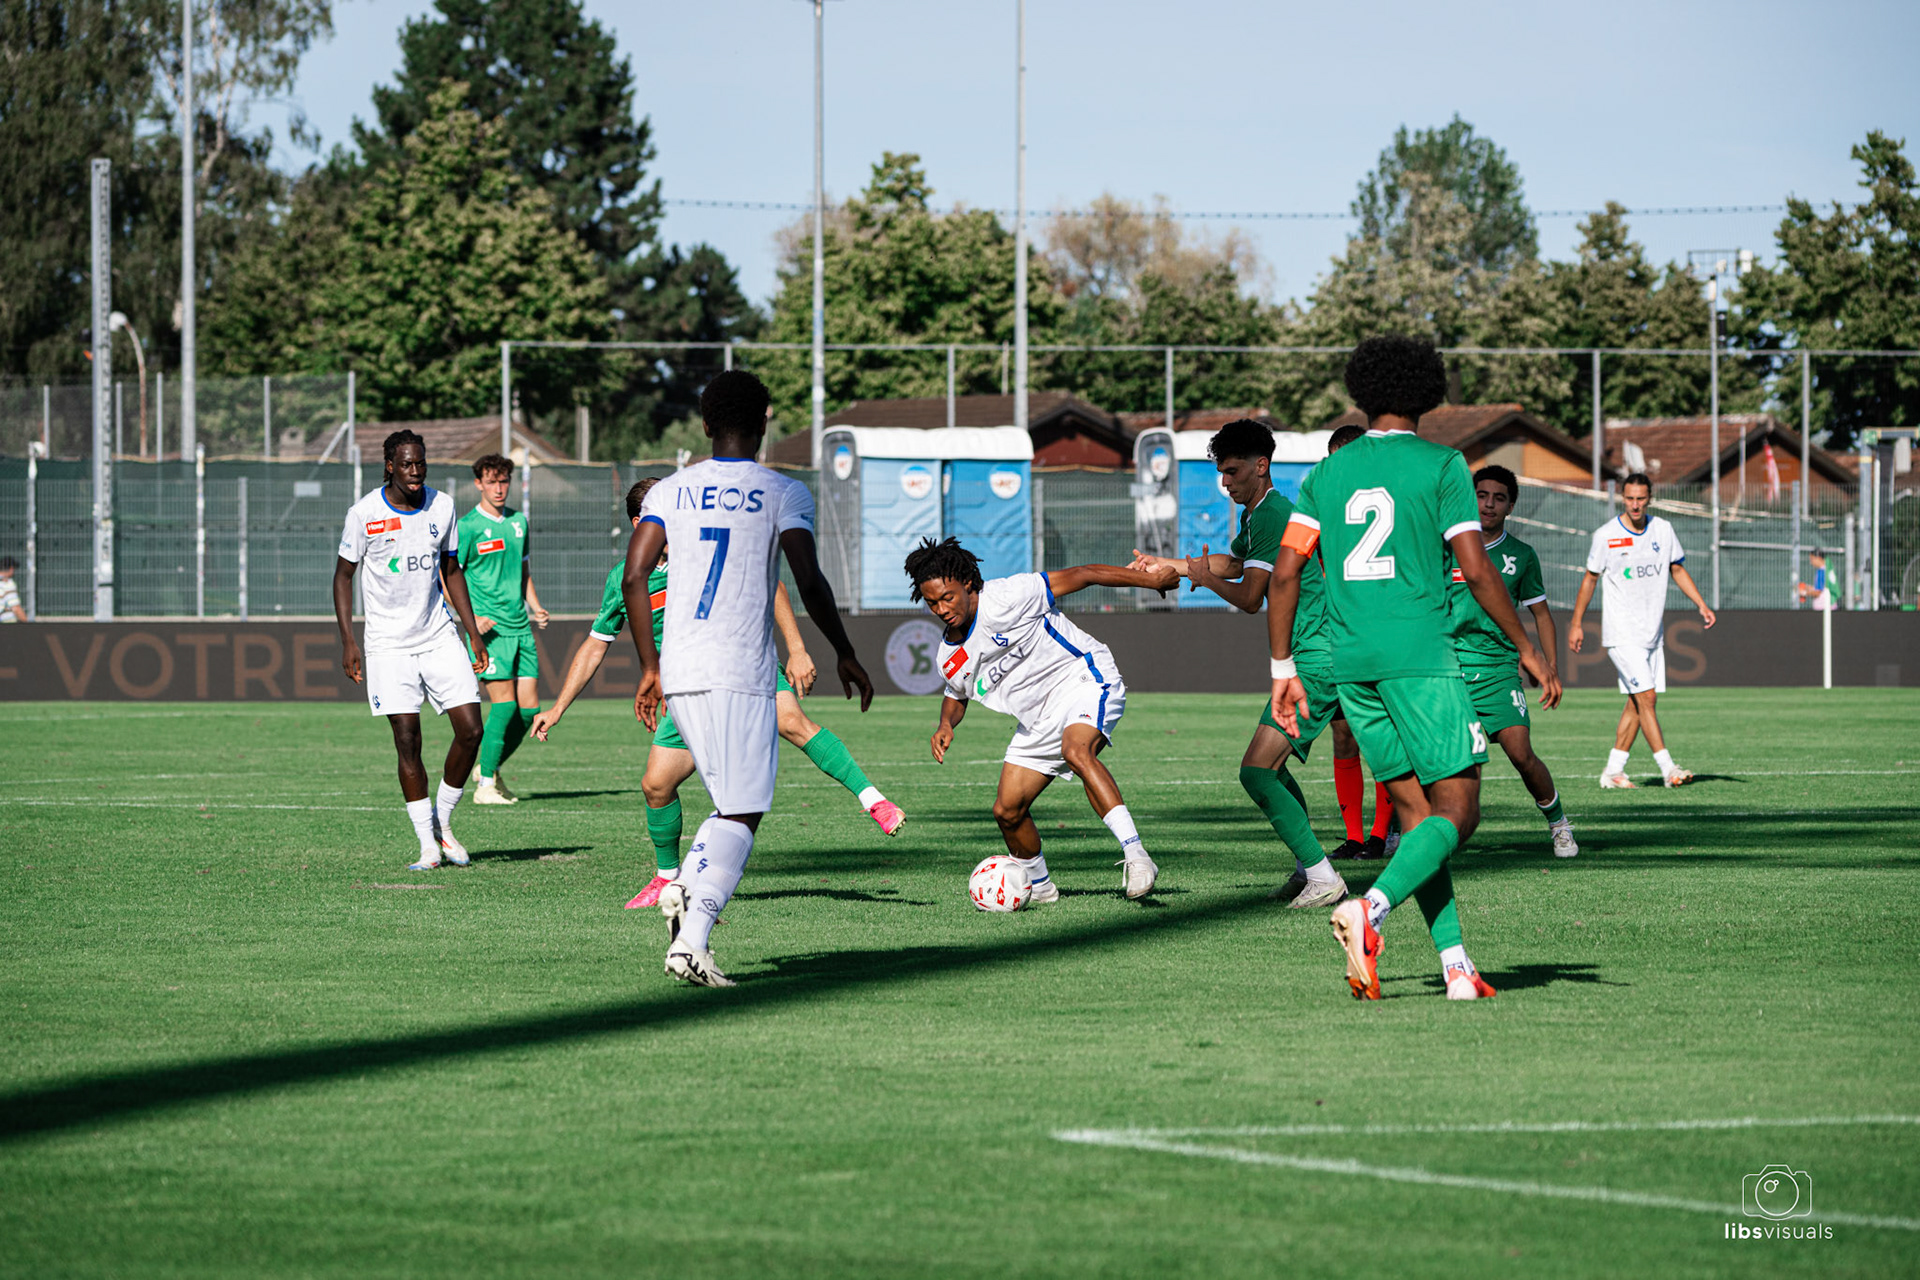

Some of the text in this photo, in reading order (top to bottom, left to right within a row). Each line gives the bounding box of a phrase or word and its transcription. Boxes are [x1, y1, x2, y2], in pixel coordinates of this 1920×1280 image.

[676, 486, 764, 513] INEOS
[1343, 486, 1396, 582] 2
[695, 527, 730, 621] 7
[1637, 563, 1663, 578] BCV
[45, 632, 340, 698] VOTRE
[988, 646, 1026, 686] BCV
[1510, 690, 1527, 708] 10
